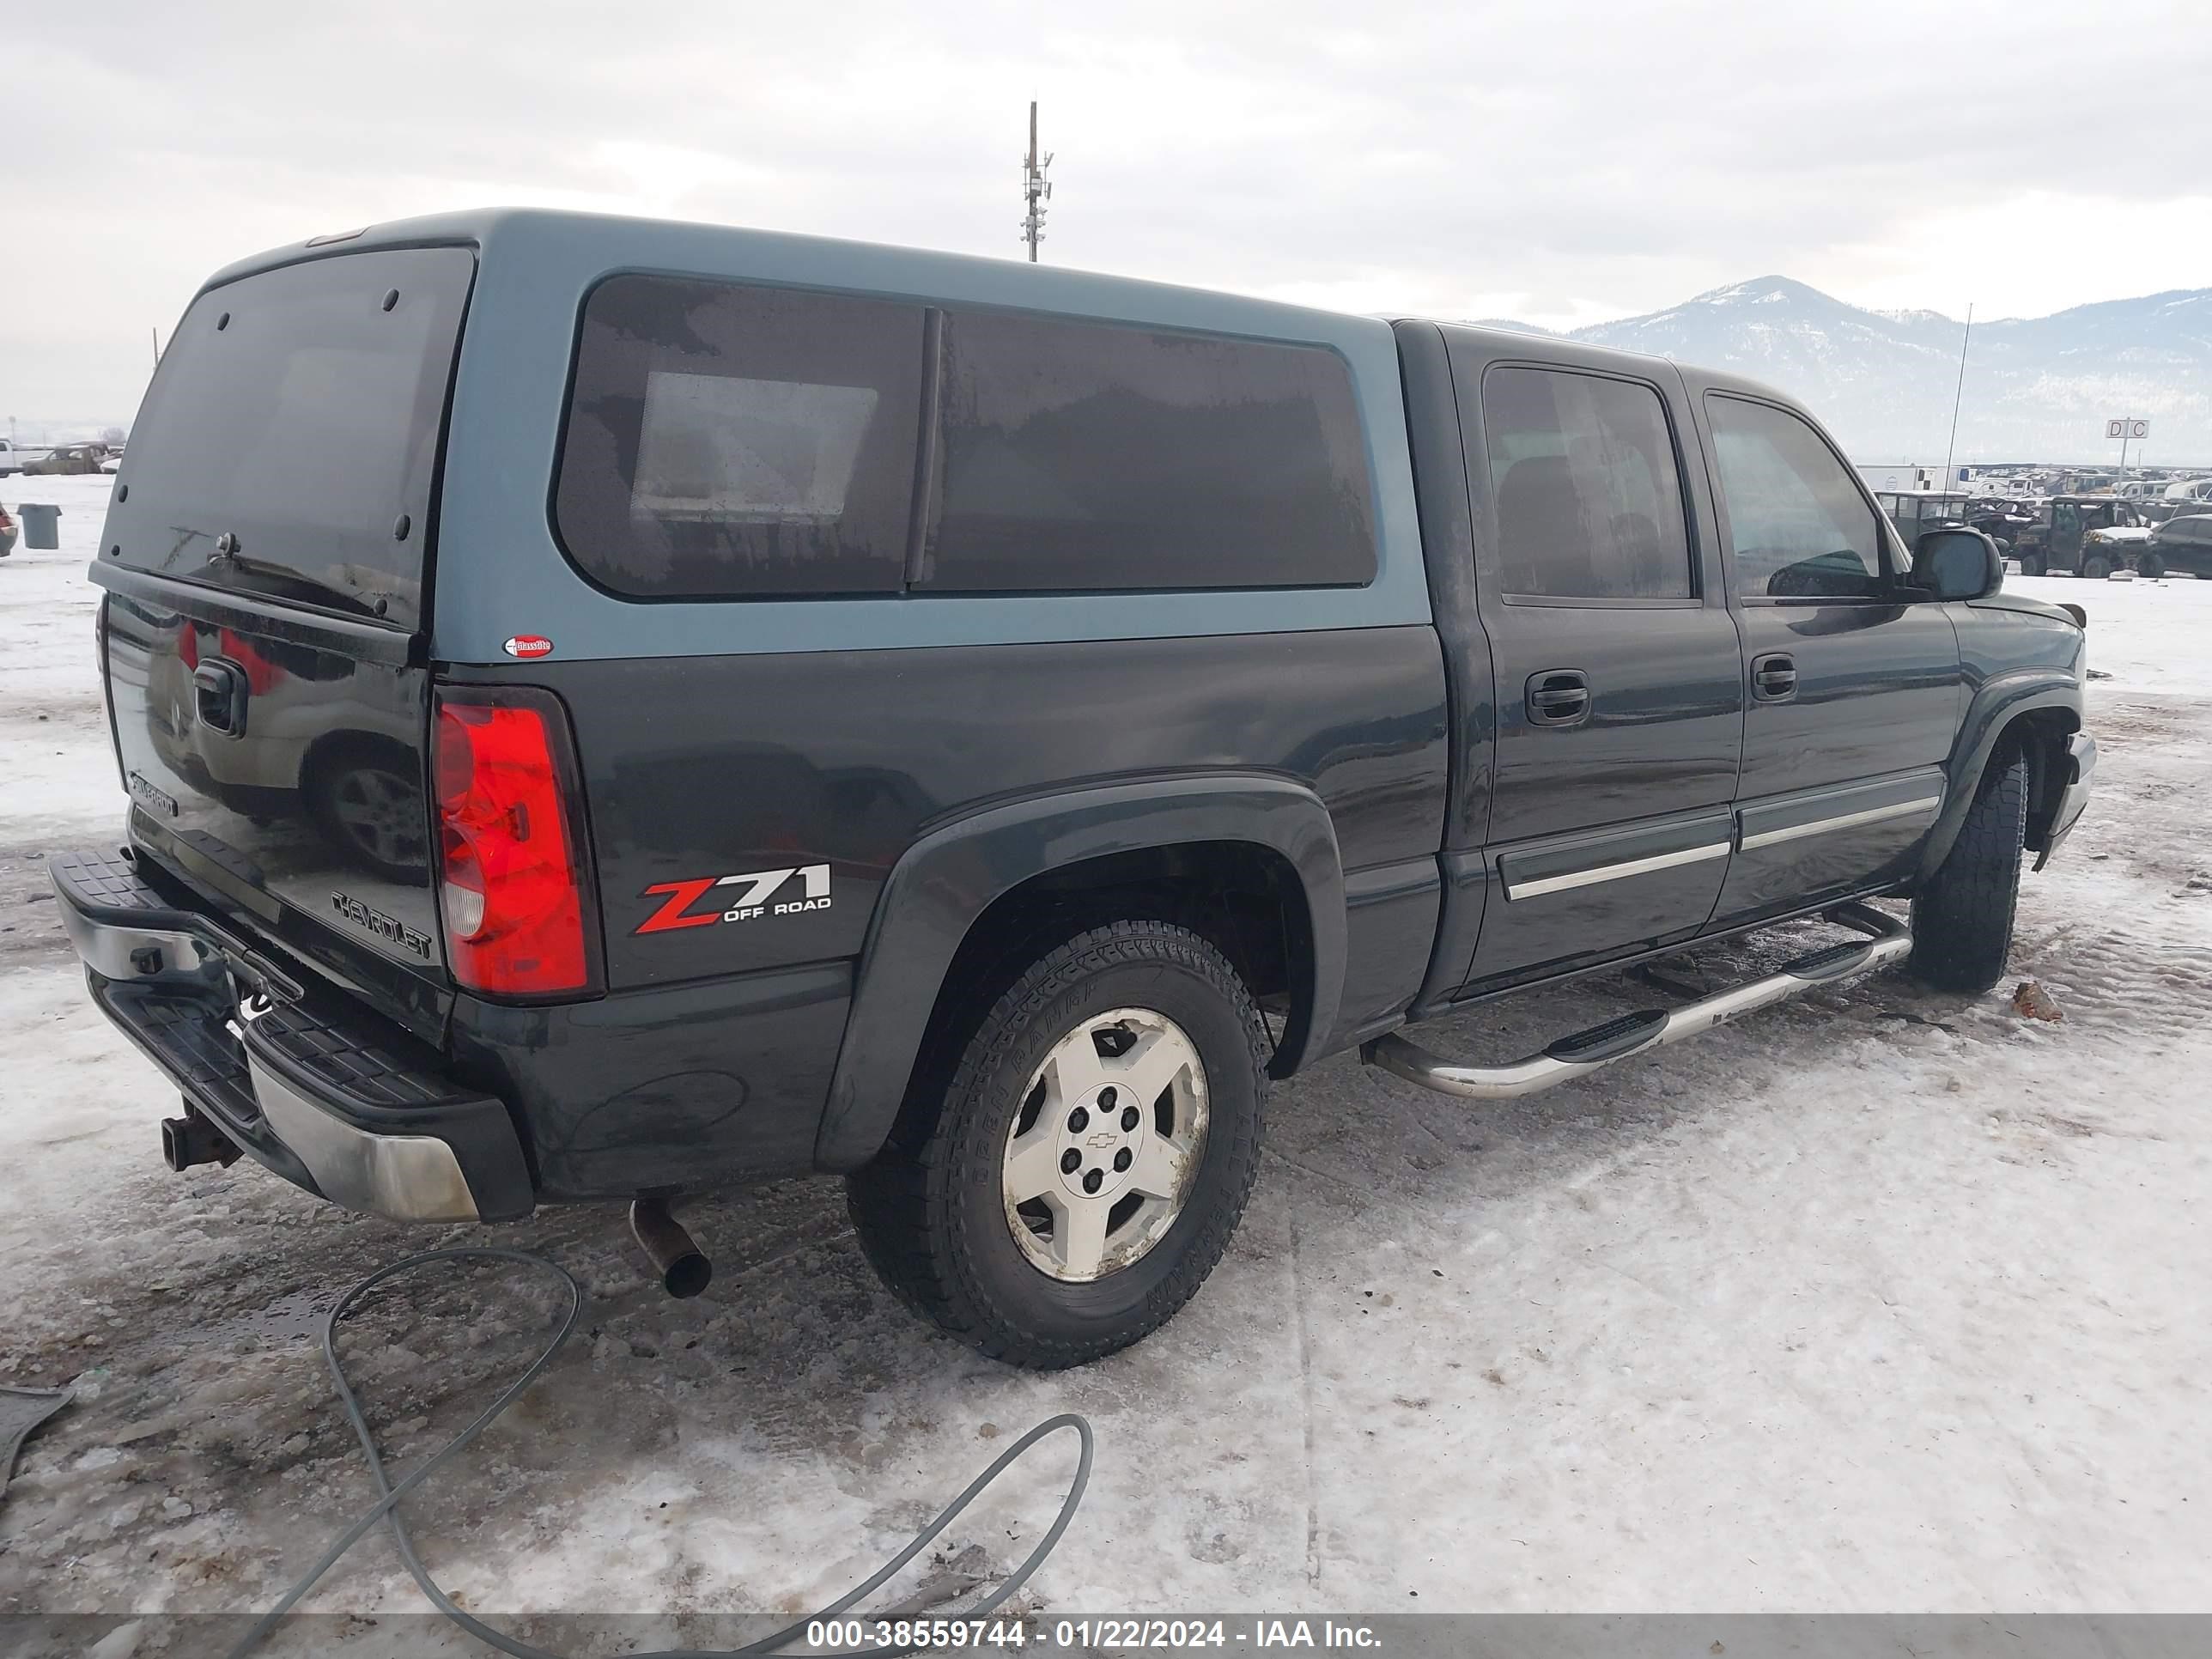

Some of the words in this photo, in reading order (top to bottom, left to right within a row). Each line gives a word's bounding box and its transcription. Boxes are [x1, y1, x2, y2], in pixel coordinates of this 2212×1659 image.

[2110, 422, 2122, 436] D
[2133, 422, 2145, 437] C
[634, 862, 831, 935] Z71
[723, 906, 765, 923] OFF
[774, 897, 832, 916] ROAD
[331, 890, 432, 959] CHEVROLET
